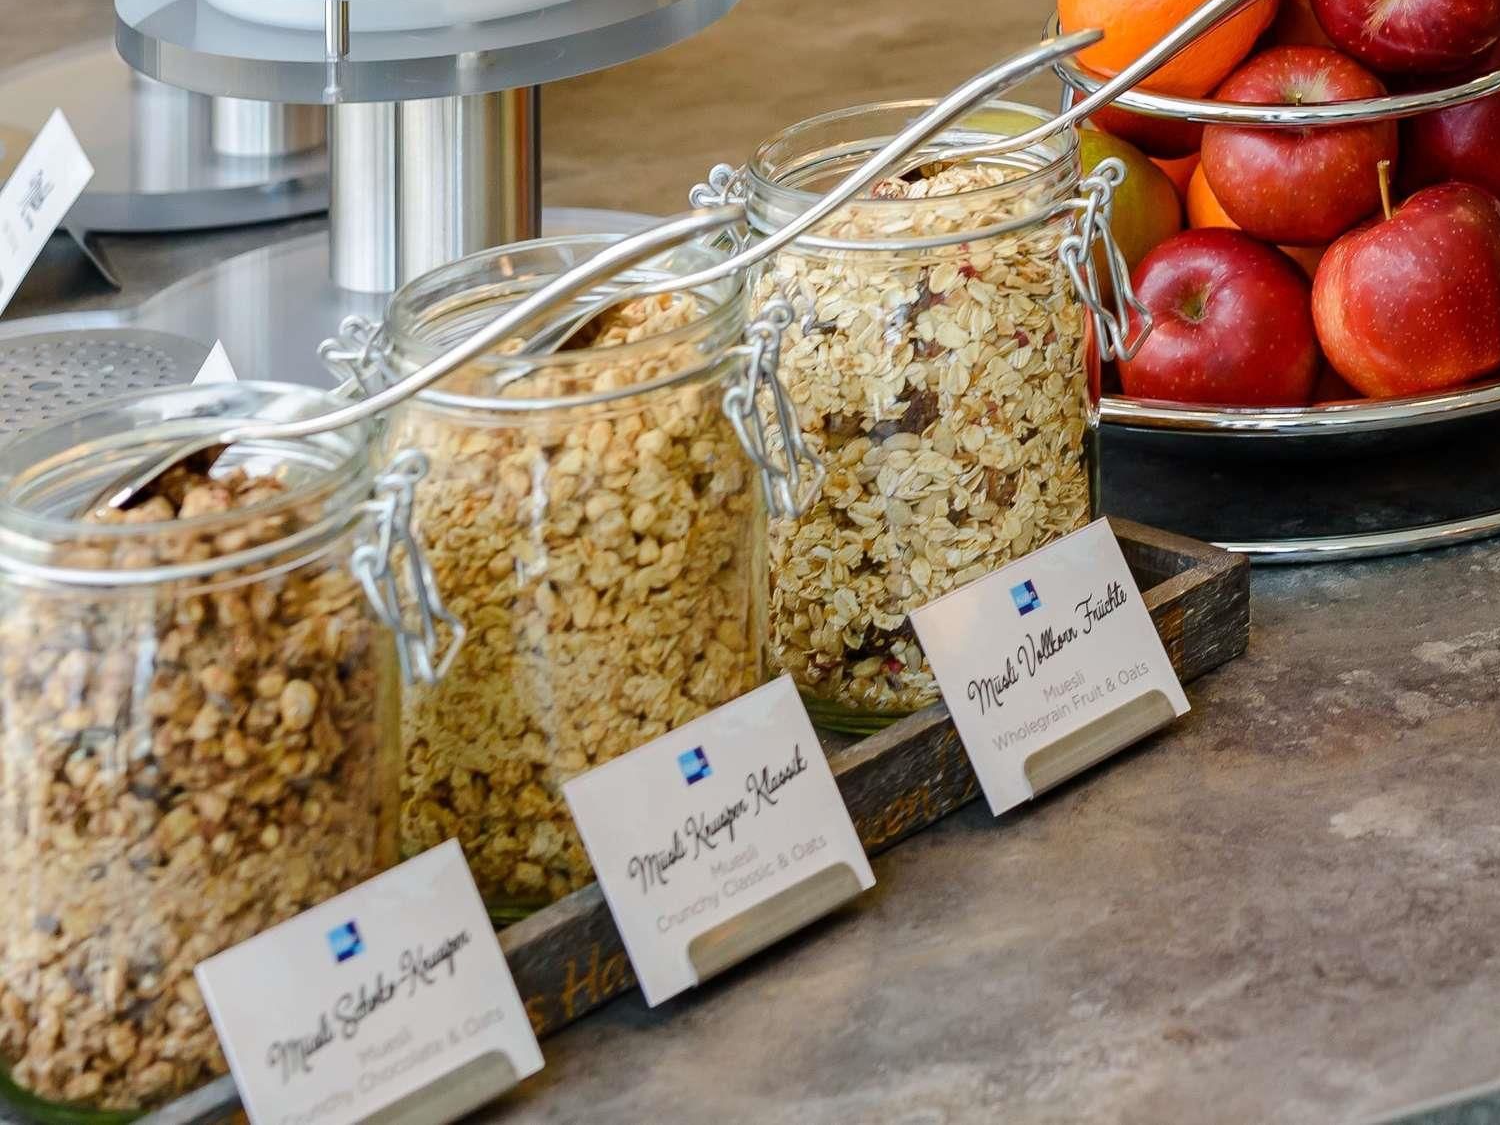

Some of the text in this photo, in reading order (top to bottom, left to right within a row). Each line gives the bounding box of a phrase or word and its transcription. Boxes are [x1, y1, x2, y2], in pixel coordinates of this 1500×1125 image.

[967, 658, 1019, 715] Müsli
[1017, 626, 1078, 678] Vollkorn
[1074, 579, 1128, 634] Früchte
[992, 661, 1150, 752] Wholegrain Fruit & Oats
[1043, 672, 1086, 702] Muesli
[790, 833, 828, 863] Oats
